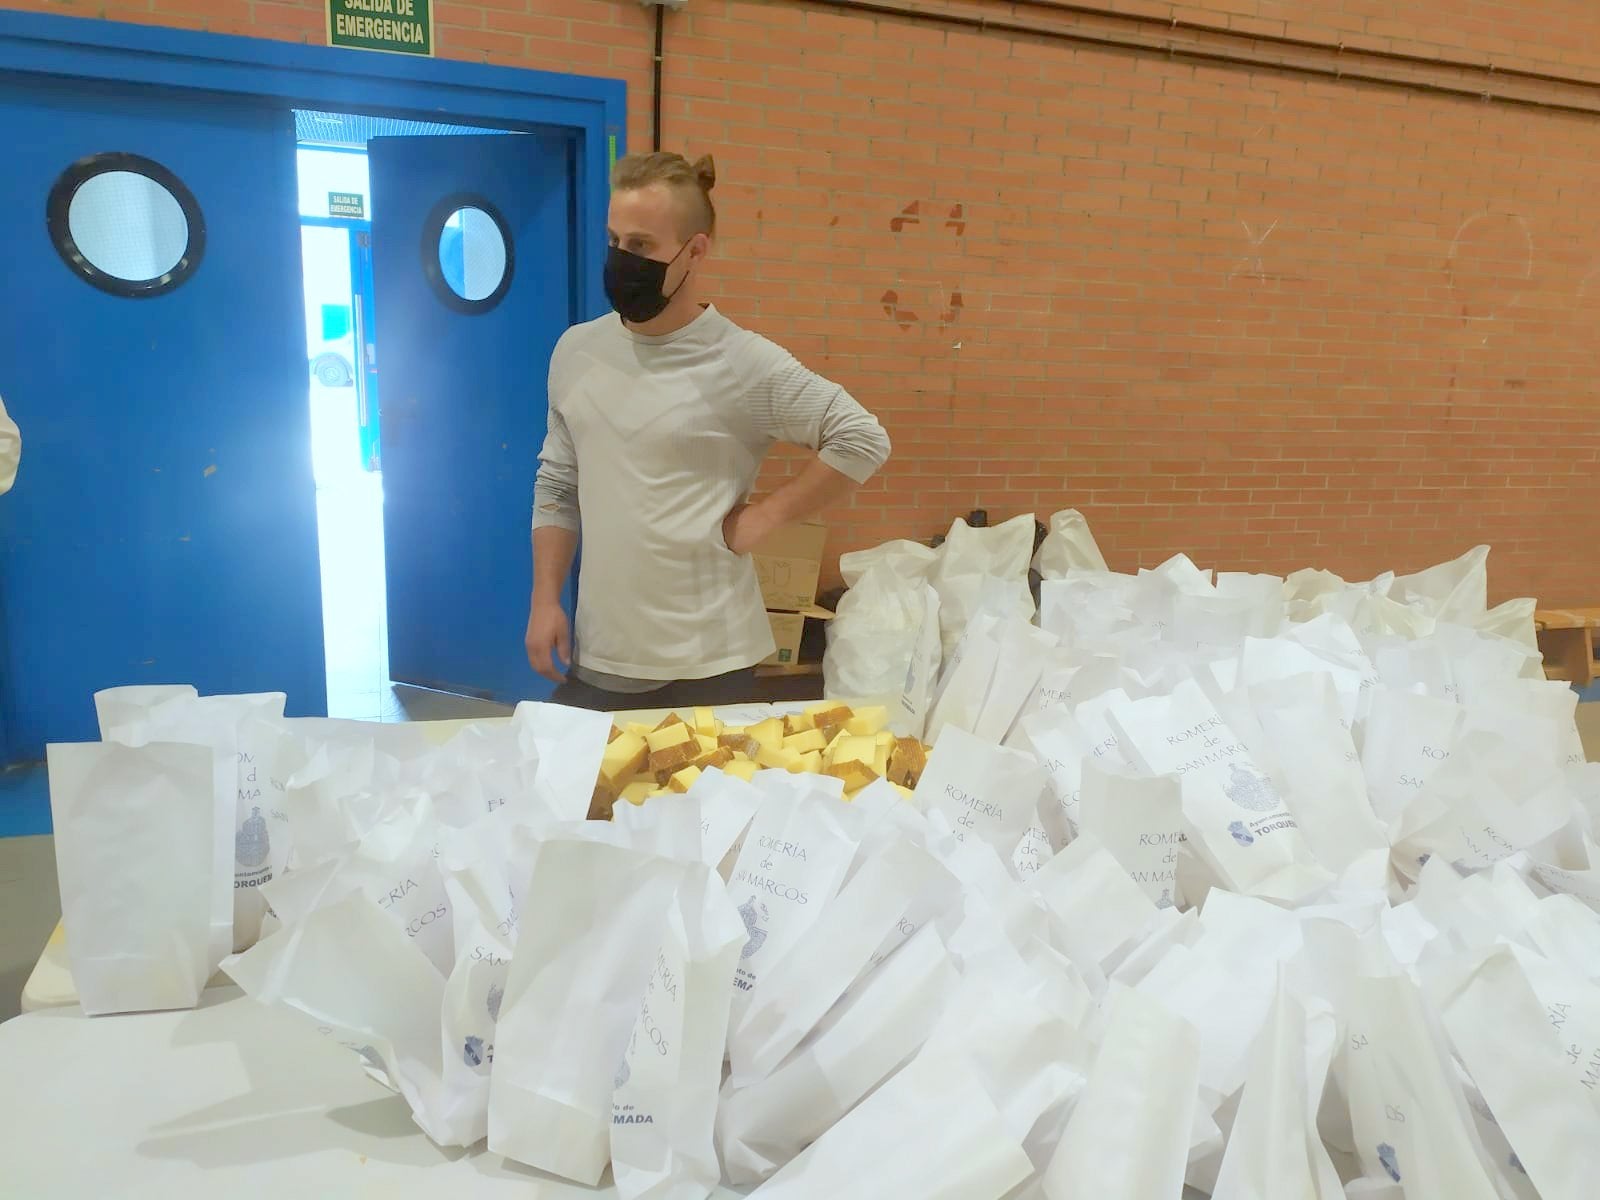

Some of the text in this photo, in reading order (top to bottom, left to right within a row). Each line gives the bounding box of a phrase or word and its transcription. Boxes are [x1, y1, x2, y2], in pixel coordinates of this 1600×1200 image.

[336, 13, 424, 44] EMERGENCIA
[1203, 735, 1220, 752] de
[944, 783, 1003, 822] ROMERÍA
[957, 811, 975, 829] de
[760, 853, 774, 871] de
